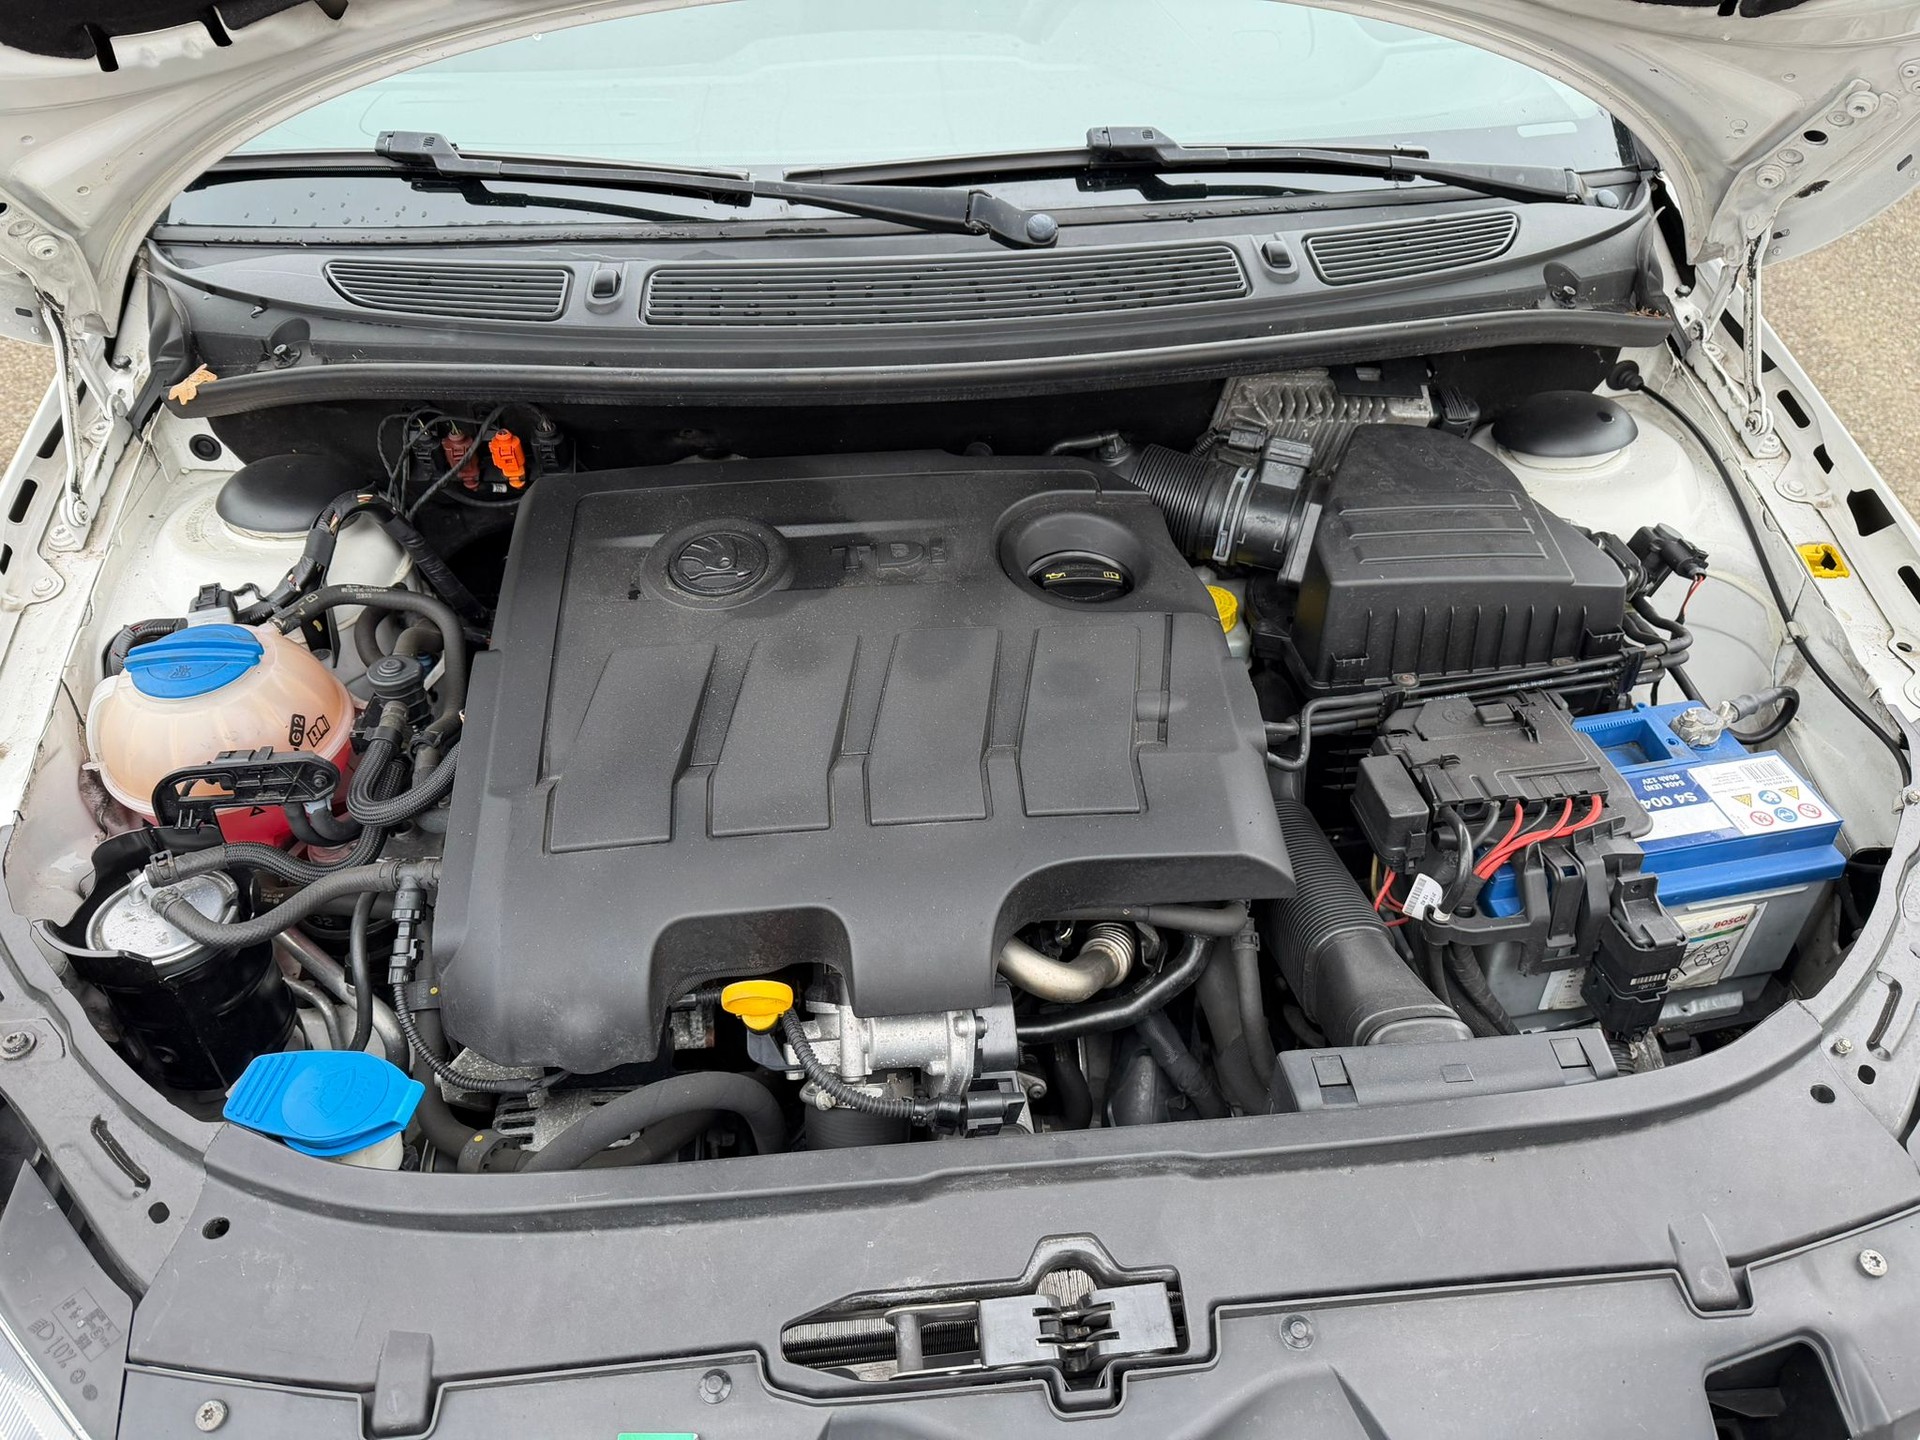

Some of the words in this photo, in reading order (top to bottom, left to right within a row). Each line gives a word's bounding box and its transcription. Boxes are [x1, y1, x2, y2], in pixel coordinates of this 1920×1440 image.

[829, 537, 947, 570] TDI
[291, 716, 304, 743] G12
[1640, 795, 1673, 809] 004
[1673, 791, 1698, 804] S4
[1713, 914, 1748, 929] BOSCH
